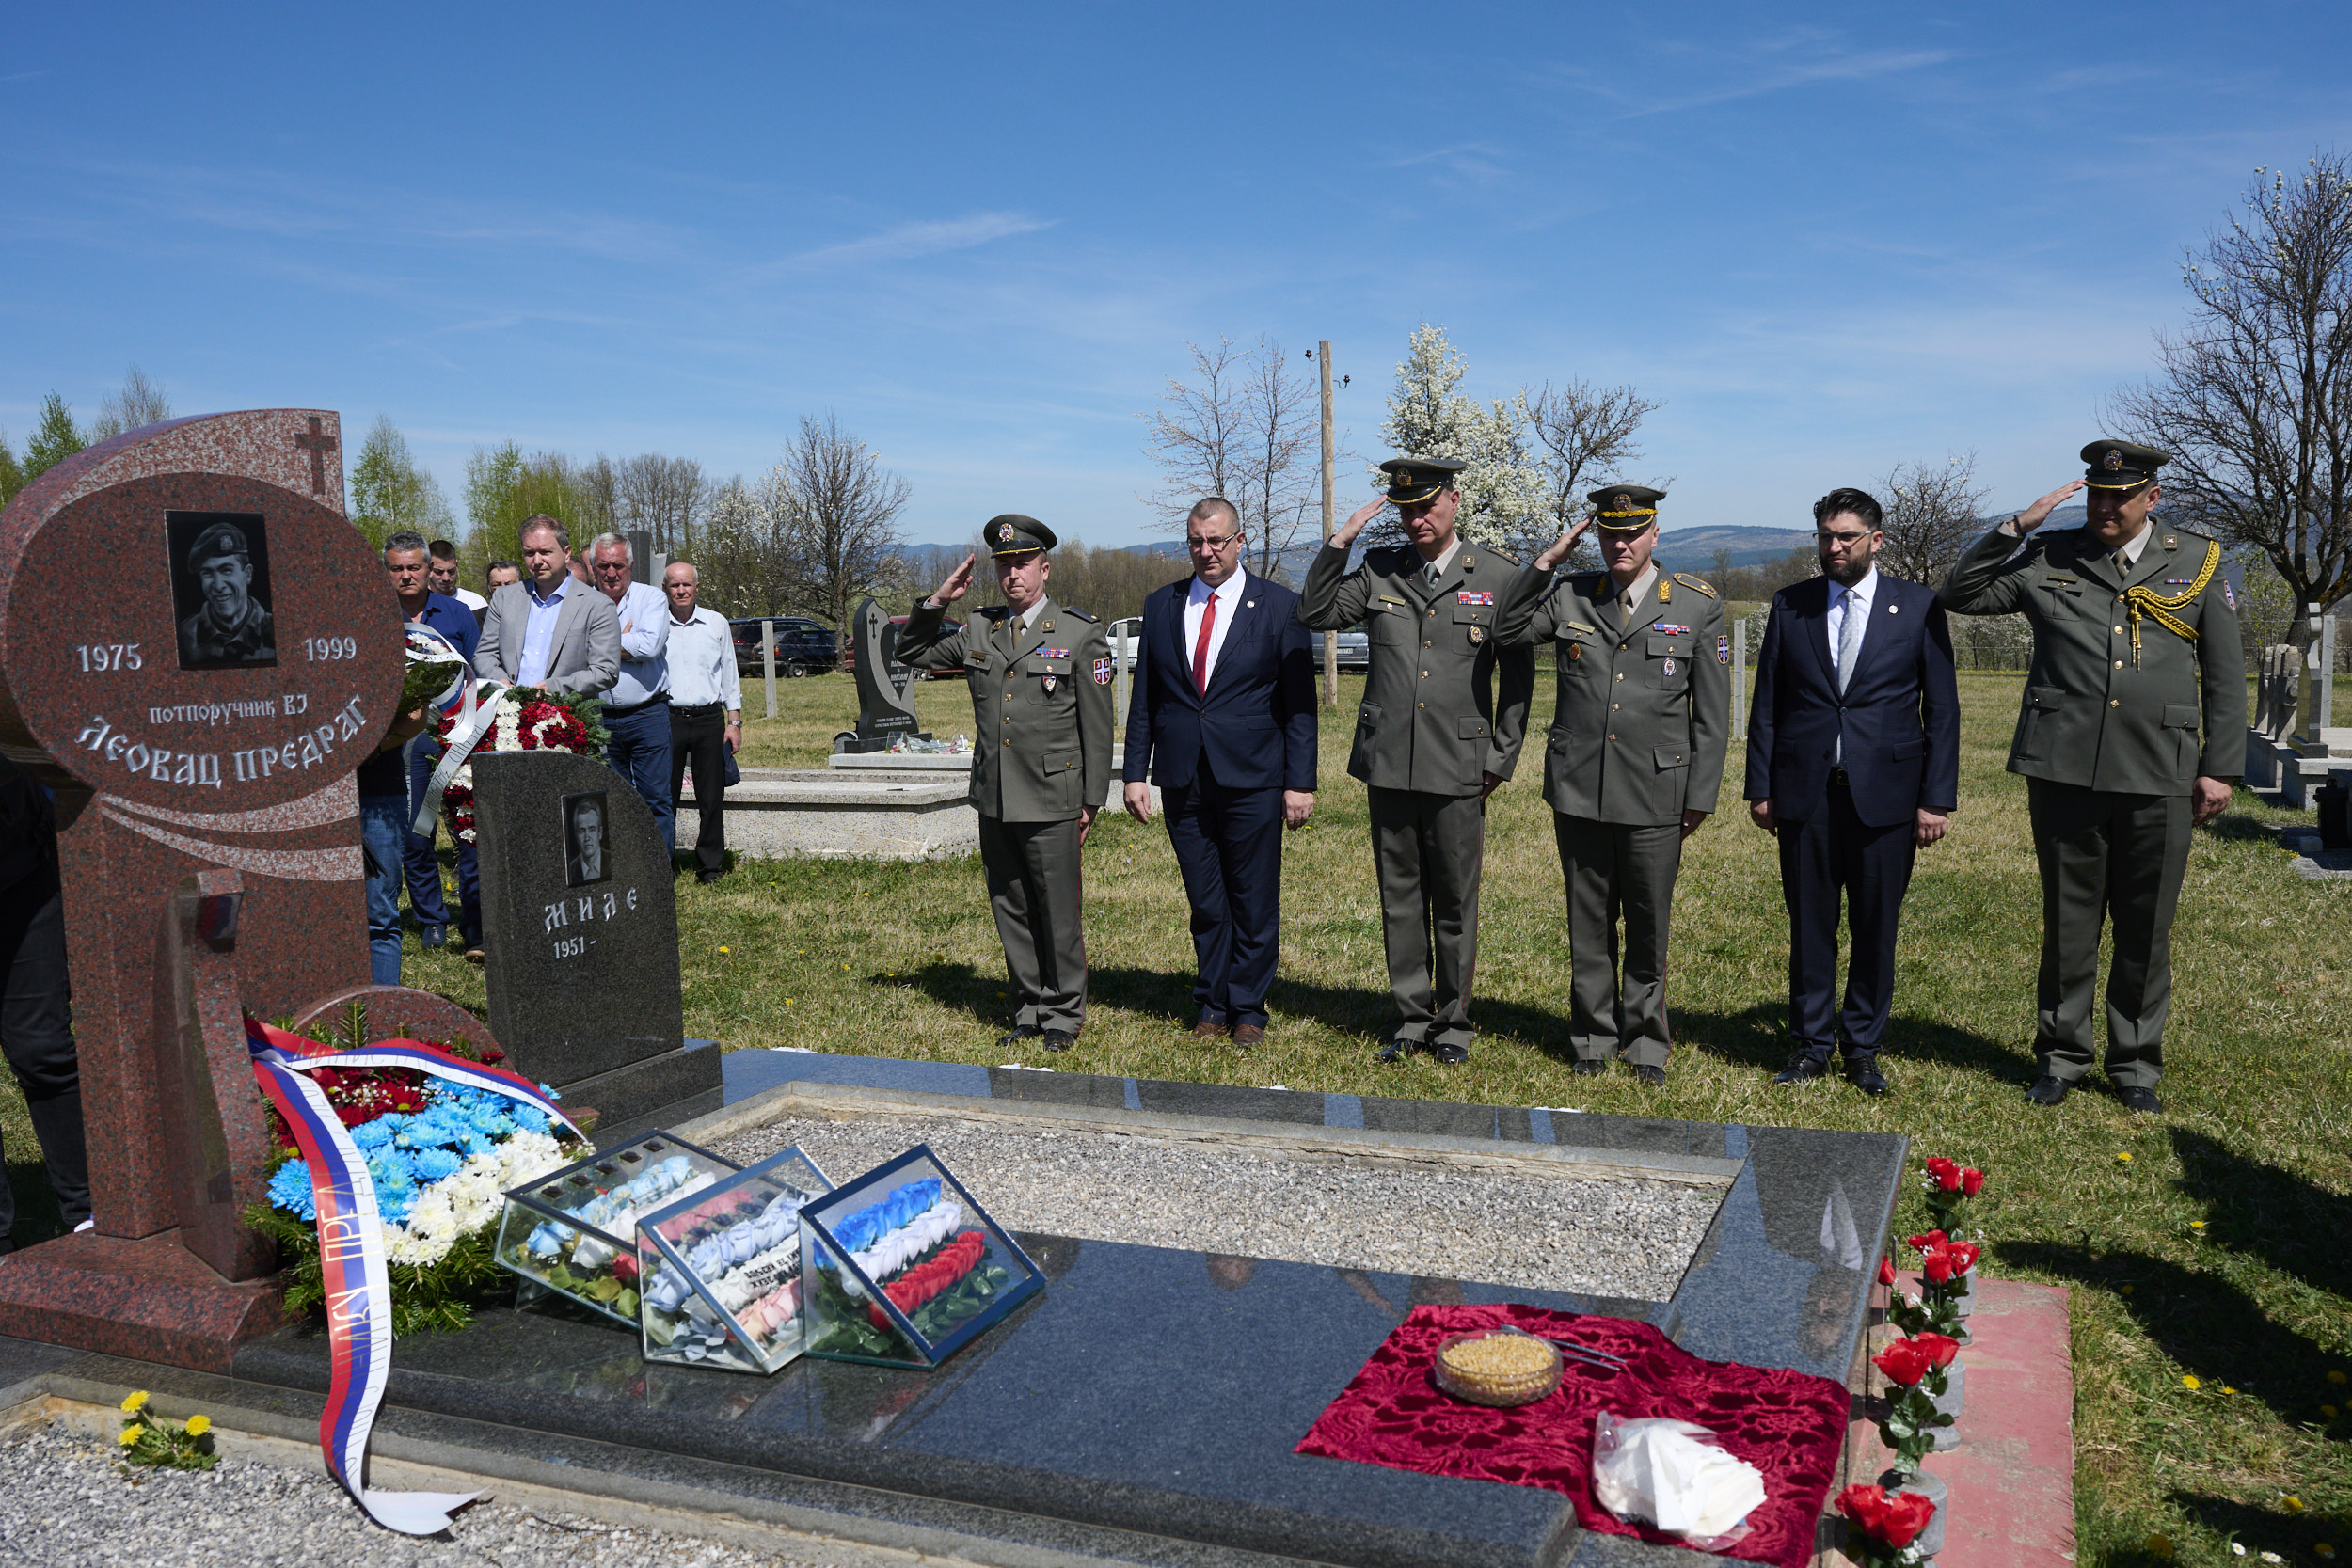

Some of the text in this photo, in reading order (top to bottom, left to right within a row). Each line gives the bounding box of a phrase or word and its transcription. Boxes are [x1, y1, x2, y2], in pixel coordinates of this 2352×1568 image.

[77, 642, 143, 672] 1975
[304, 636, 357, 662] 1999
[297, 1127, 382, 1262] ПРЕДРАГУ
